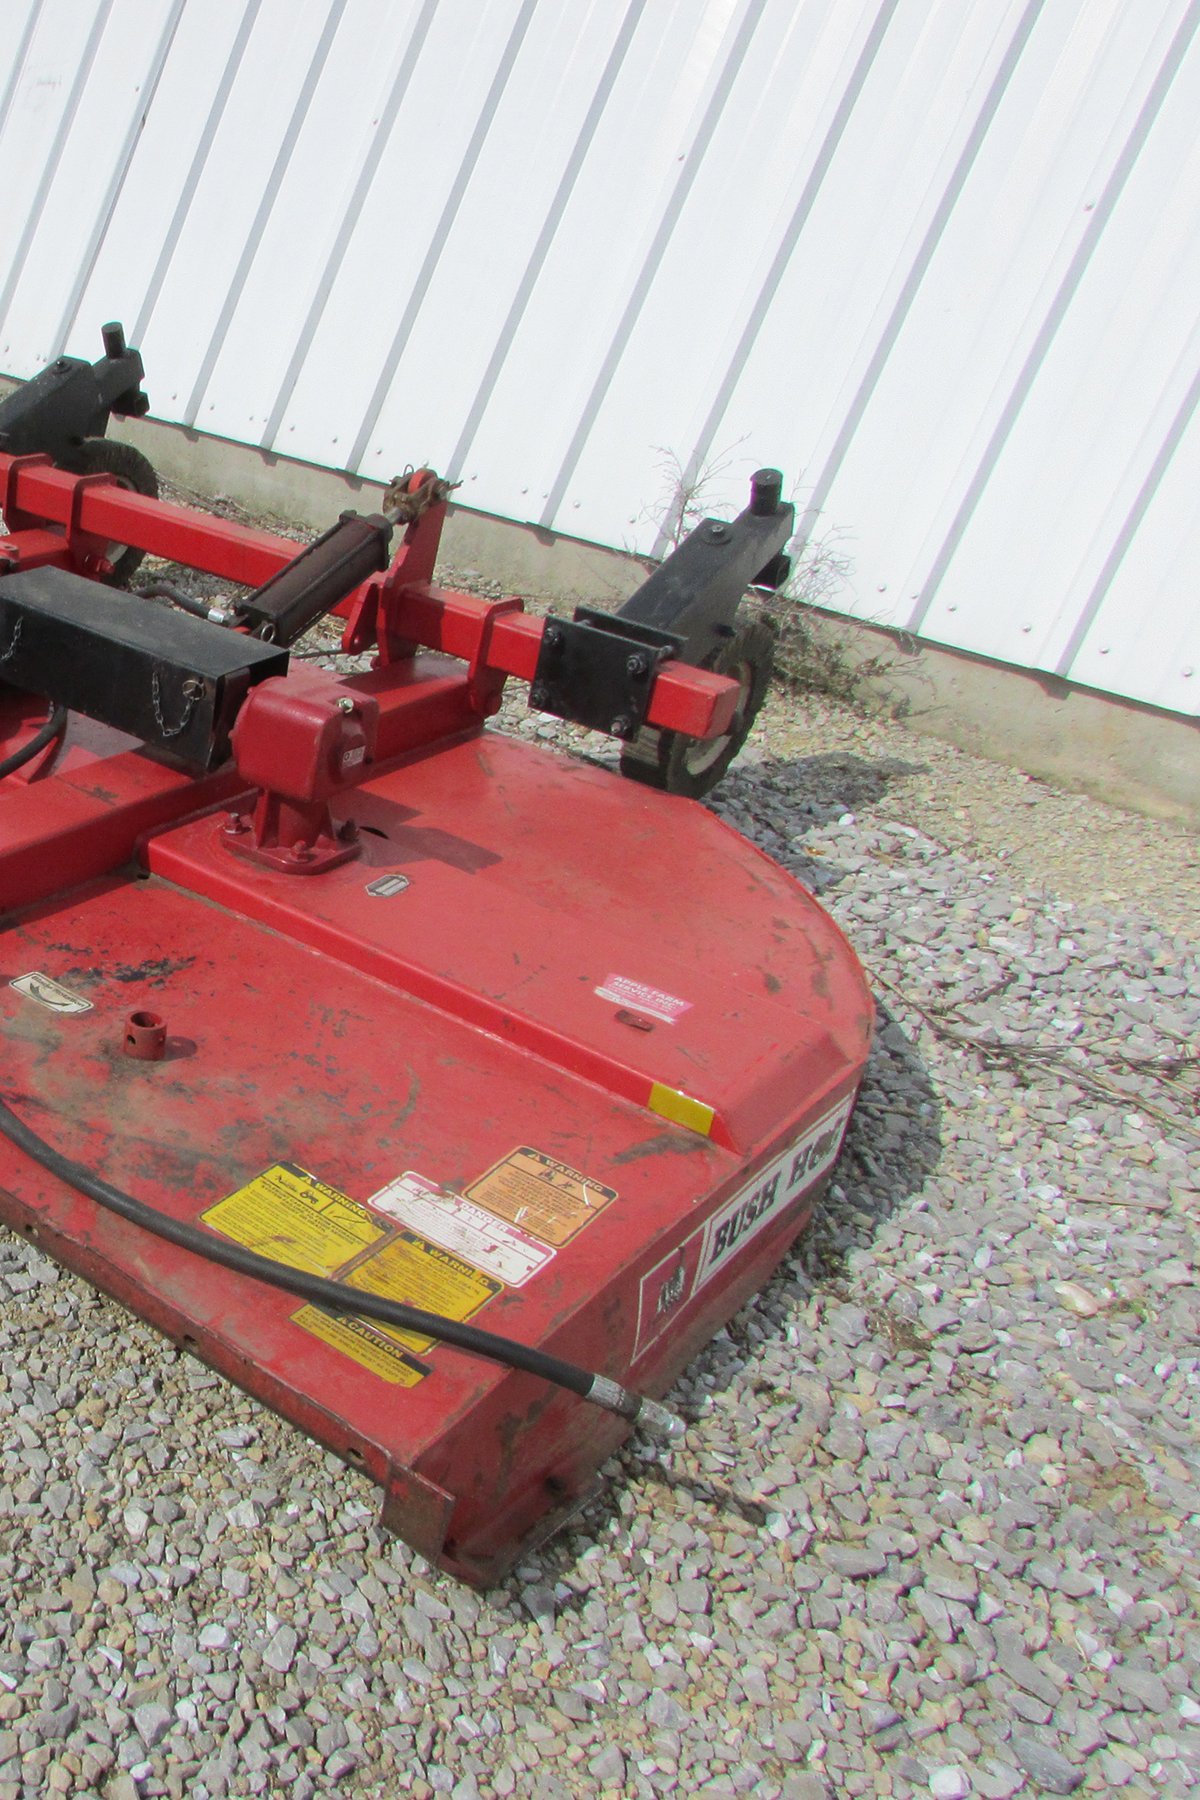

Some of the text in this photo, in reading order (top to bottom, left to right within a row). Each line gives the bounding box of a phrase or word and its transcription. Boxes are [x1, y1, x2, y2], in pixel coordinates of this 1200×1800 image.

[545, 1159, 604, 1192] WARNING
[314, 1182, 368, 1218] WARNING
[460, 1203, 509, 1232] DANGER
[709, 1169, 782, 1265] BUSH
[429, 1249, 490, 1286] WARNIG
[348, 1322, 405, 1358] CAUTION
